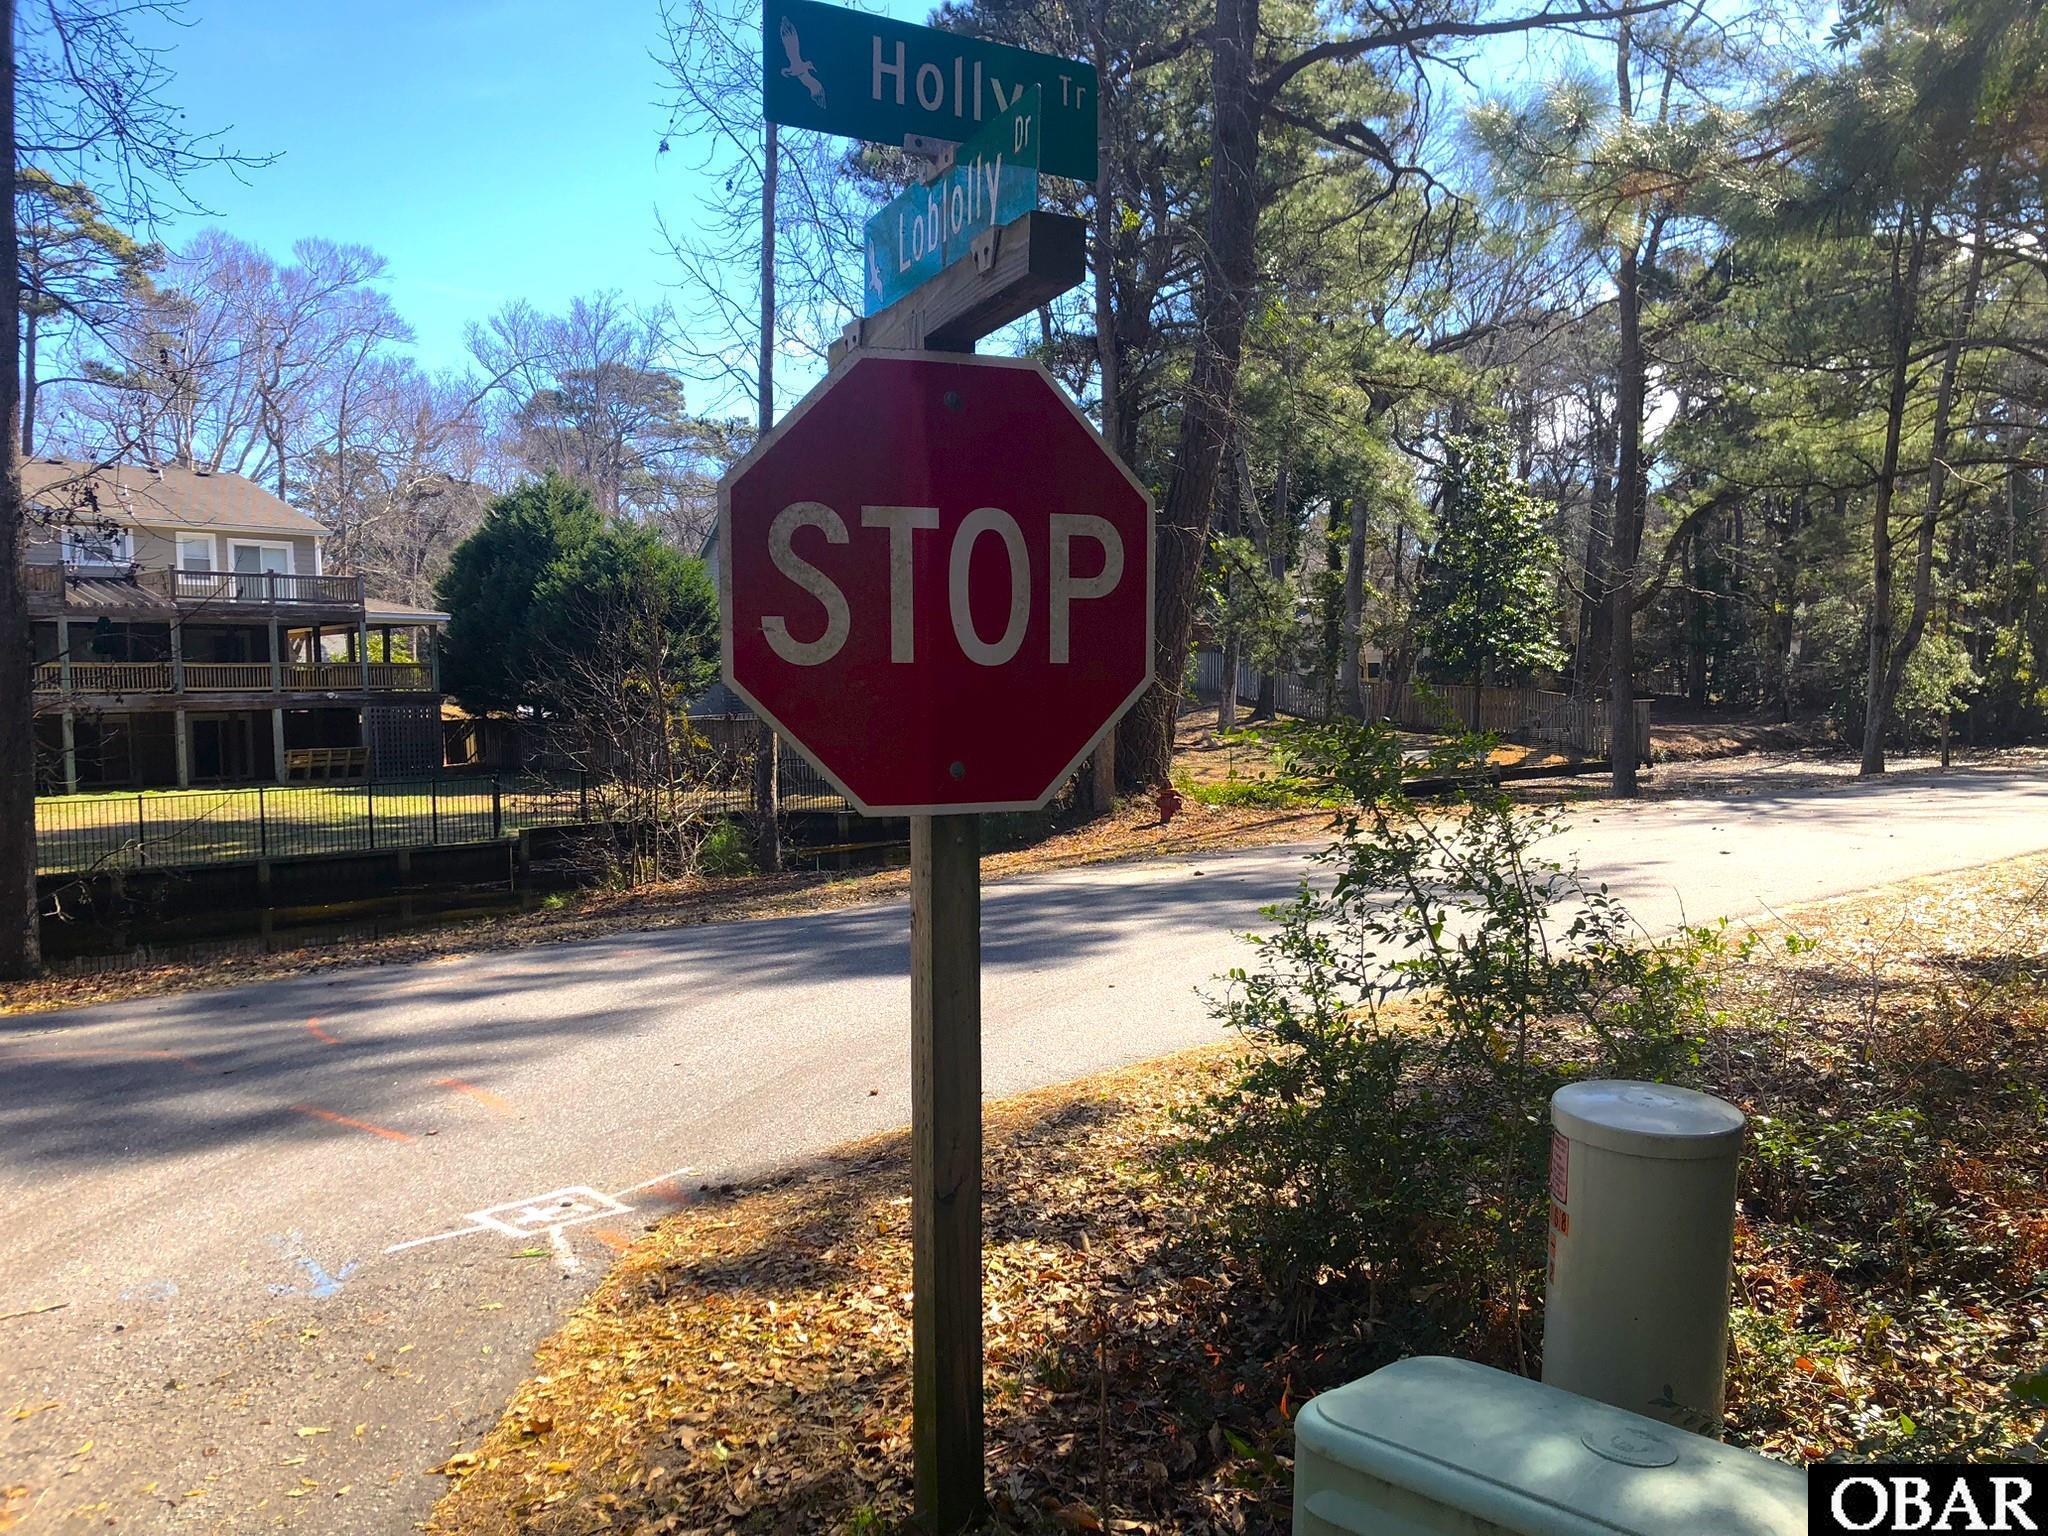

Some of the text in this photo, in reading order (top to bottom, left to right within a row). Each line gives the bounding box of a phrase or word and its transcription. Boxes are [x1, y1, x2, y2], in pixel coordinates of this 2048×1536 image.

[1059, 74, 1086, 110] Tr
[899, 115, 1031, 273] Loblolly Dr
[761, 501, 1124, 666] STOP
